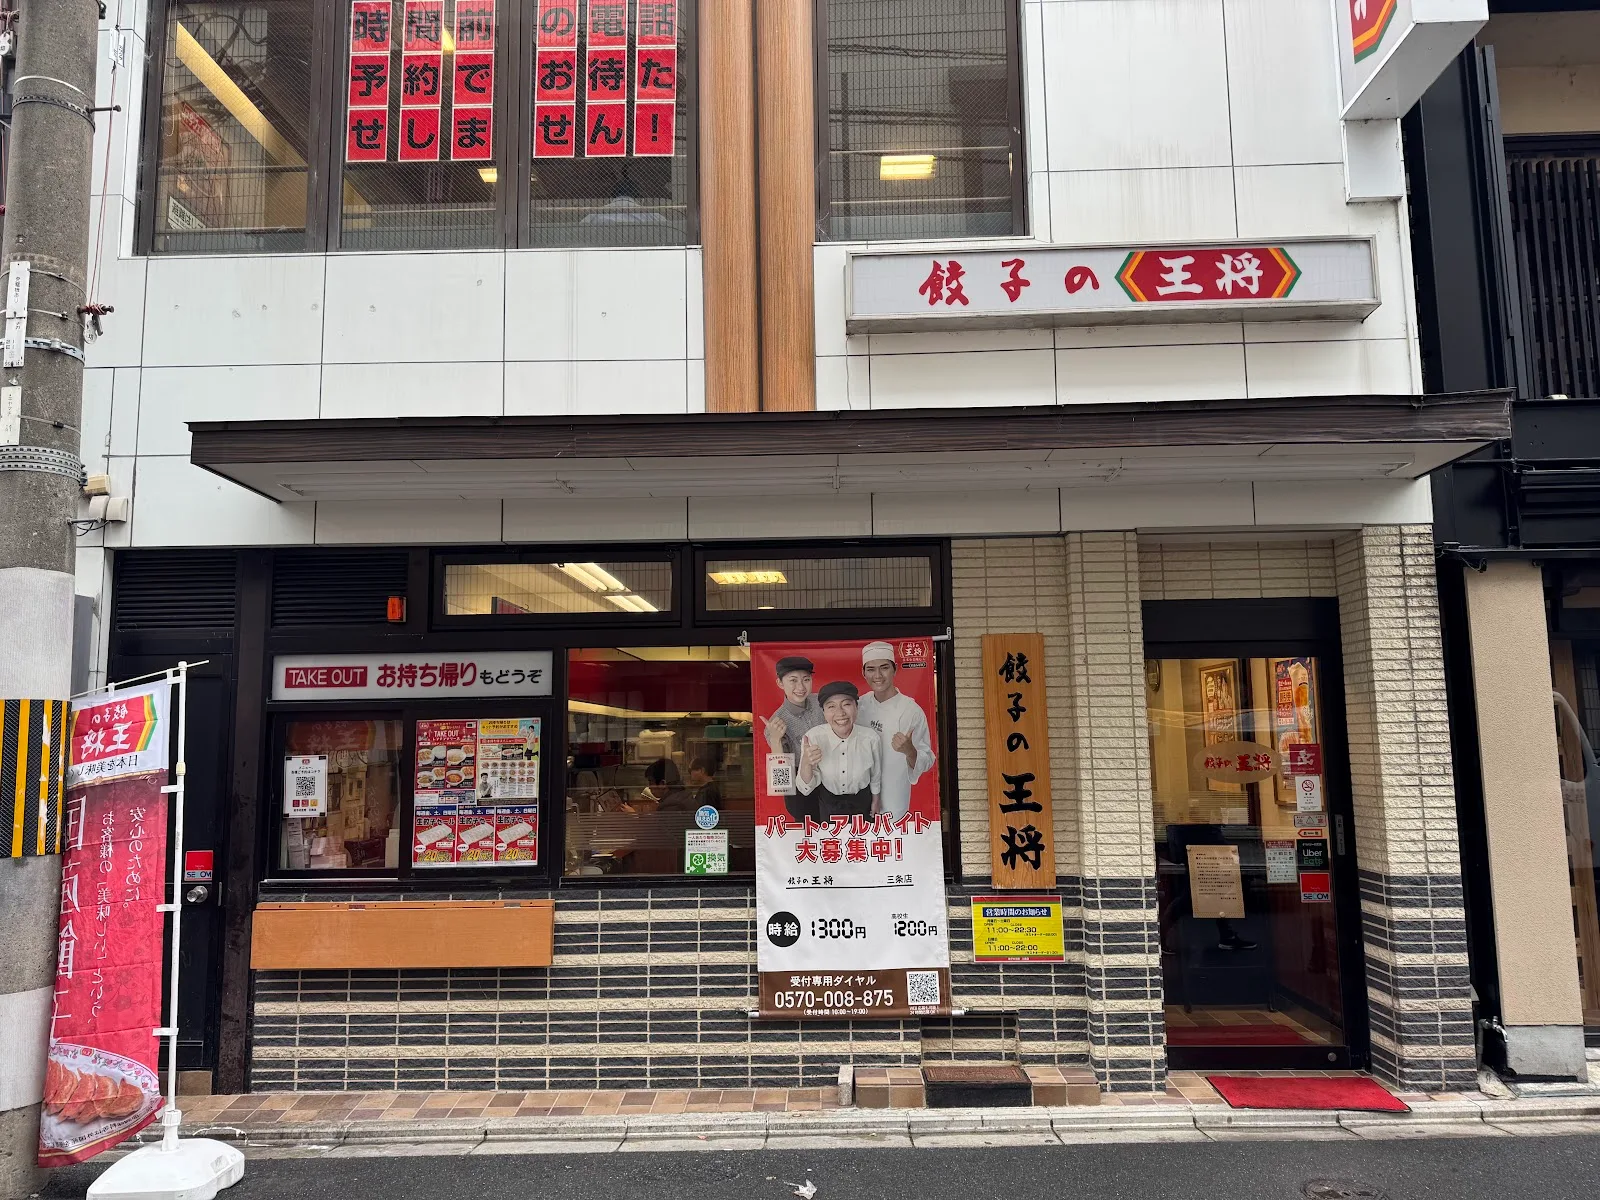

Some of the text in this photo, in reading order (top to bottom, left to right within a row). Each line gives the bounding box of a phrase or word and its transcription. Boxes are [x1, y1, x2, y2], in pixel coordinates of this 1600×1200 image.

[288, 668, 365, 686] TAKE OUT
[998, 651, 1046, 871] 餃子の王将
[764, 811, 932, 838] パート・アルバイト
[707, 853, 726, 863] 換気
[1302, 848, 1322, 856] Uber
[1303, 857, 1323, 865] Eats
[887, 874, 913, 884] 三条店
[985, 907, 1048, 917] 営業時間のお知らせ
[768, 918, 938, 939] 時給 1300円 1200円
[790, 975, 877, 988] 受付専用ダイヤル
[774, 989, 894, 1009] 0570-008-875
